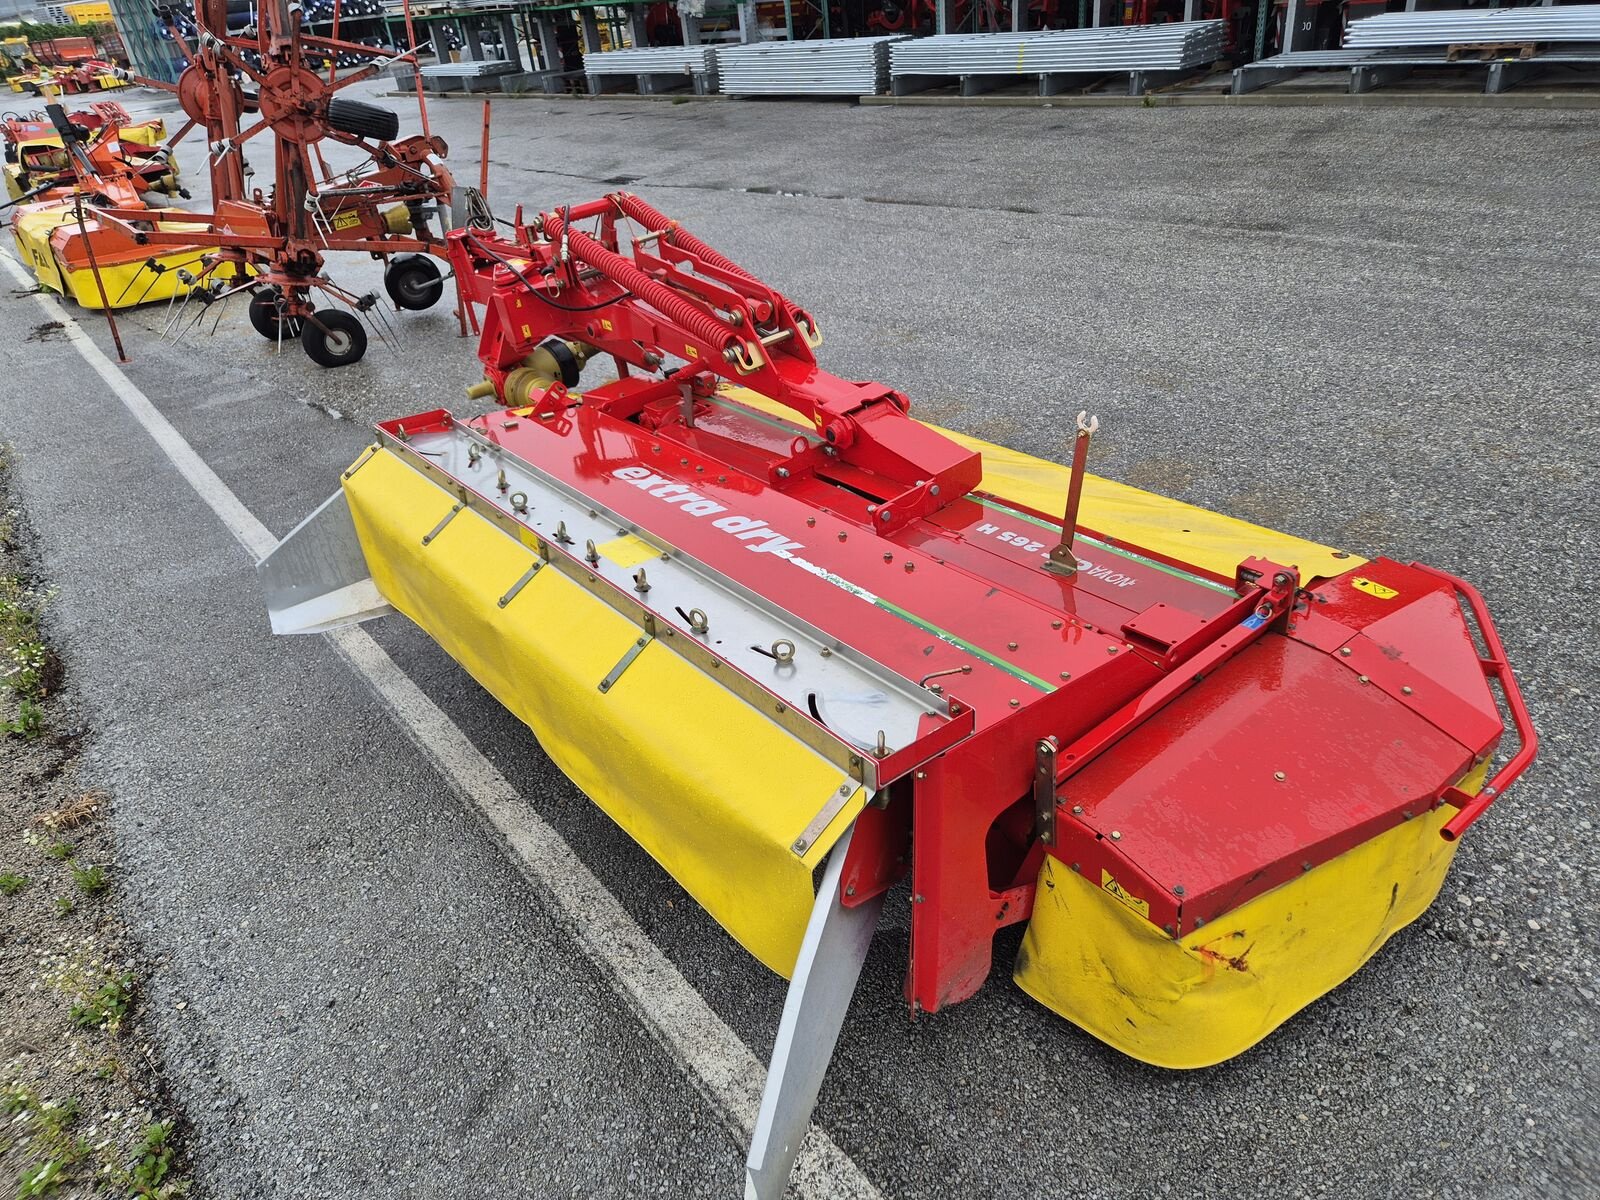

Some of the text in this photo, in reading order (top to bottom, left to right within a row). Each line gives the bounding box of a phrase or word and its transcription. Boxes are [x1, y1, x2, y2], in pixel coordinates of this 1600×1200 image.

[612, 467, 806, 553] extra dry
[975, 523, 1136, 588] NOVAC 265 H
